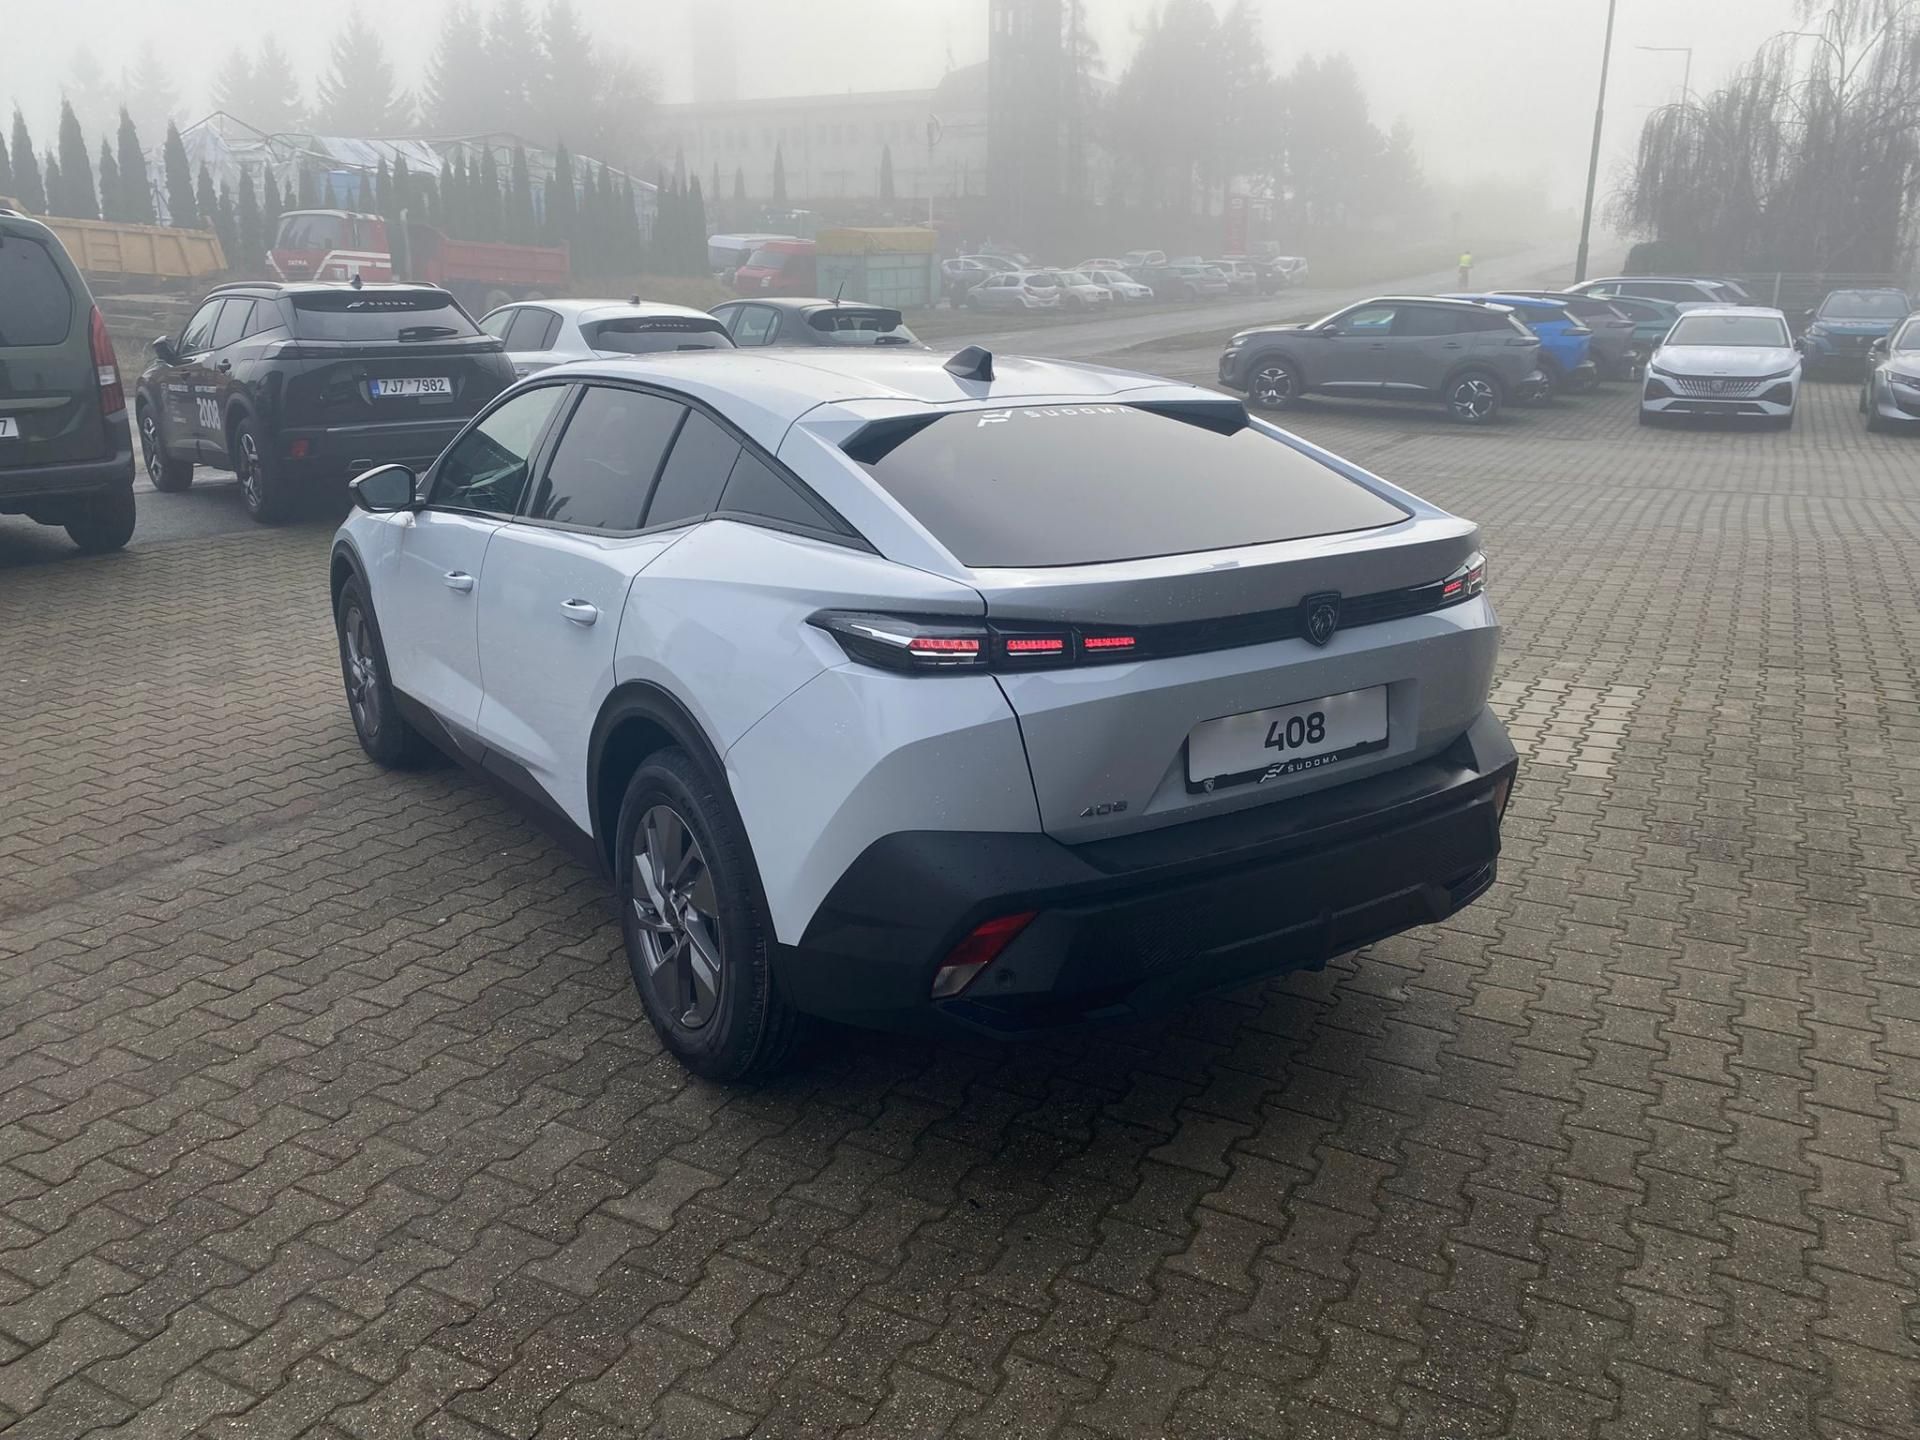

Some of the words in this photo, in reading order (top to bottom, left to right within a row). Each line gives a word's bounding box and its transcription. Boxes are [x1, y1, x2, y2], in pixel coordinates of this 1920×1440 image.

[381, 380, 404, 394] 7J7
[413, 379, 446, 393] 7982
[196, 397, 221, 431] 2008
[1023, 406, 1134, 418] SUDOMA
[1264, 711, 1326, 752] 408
[1286, 754, 1339, 774] SUDOMA
[1079, 800, 1128, 817] 408
